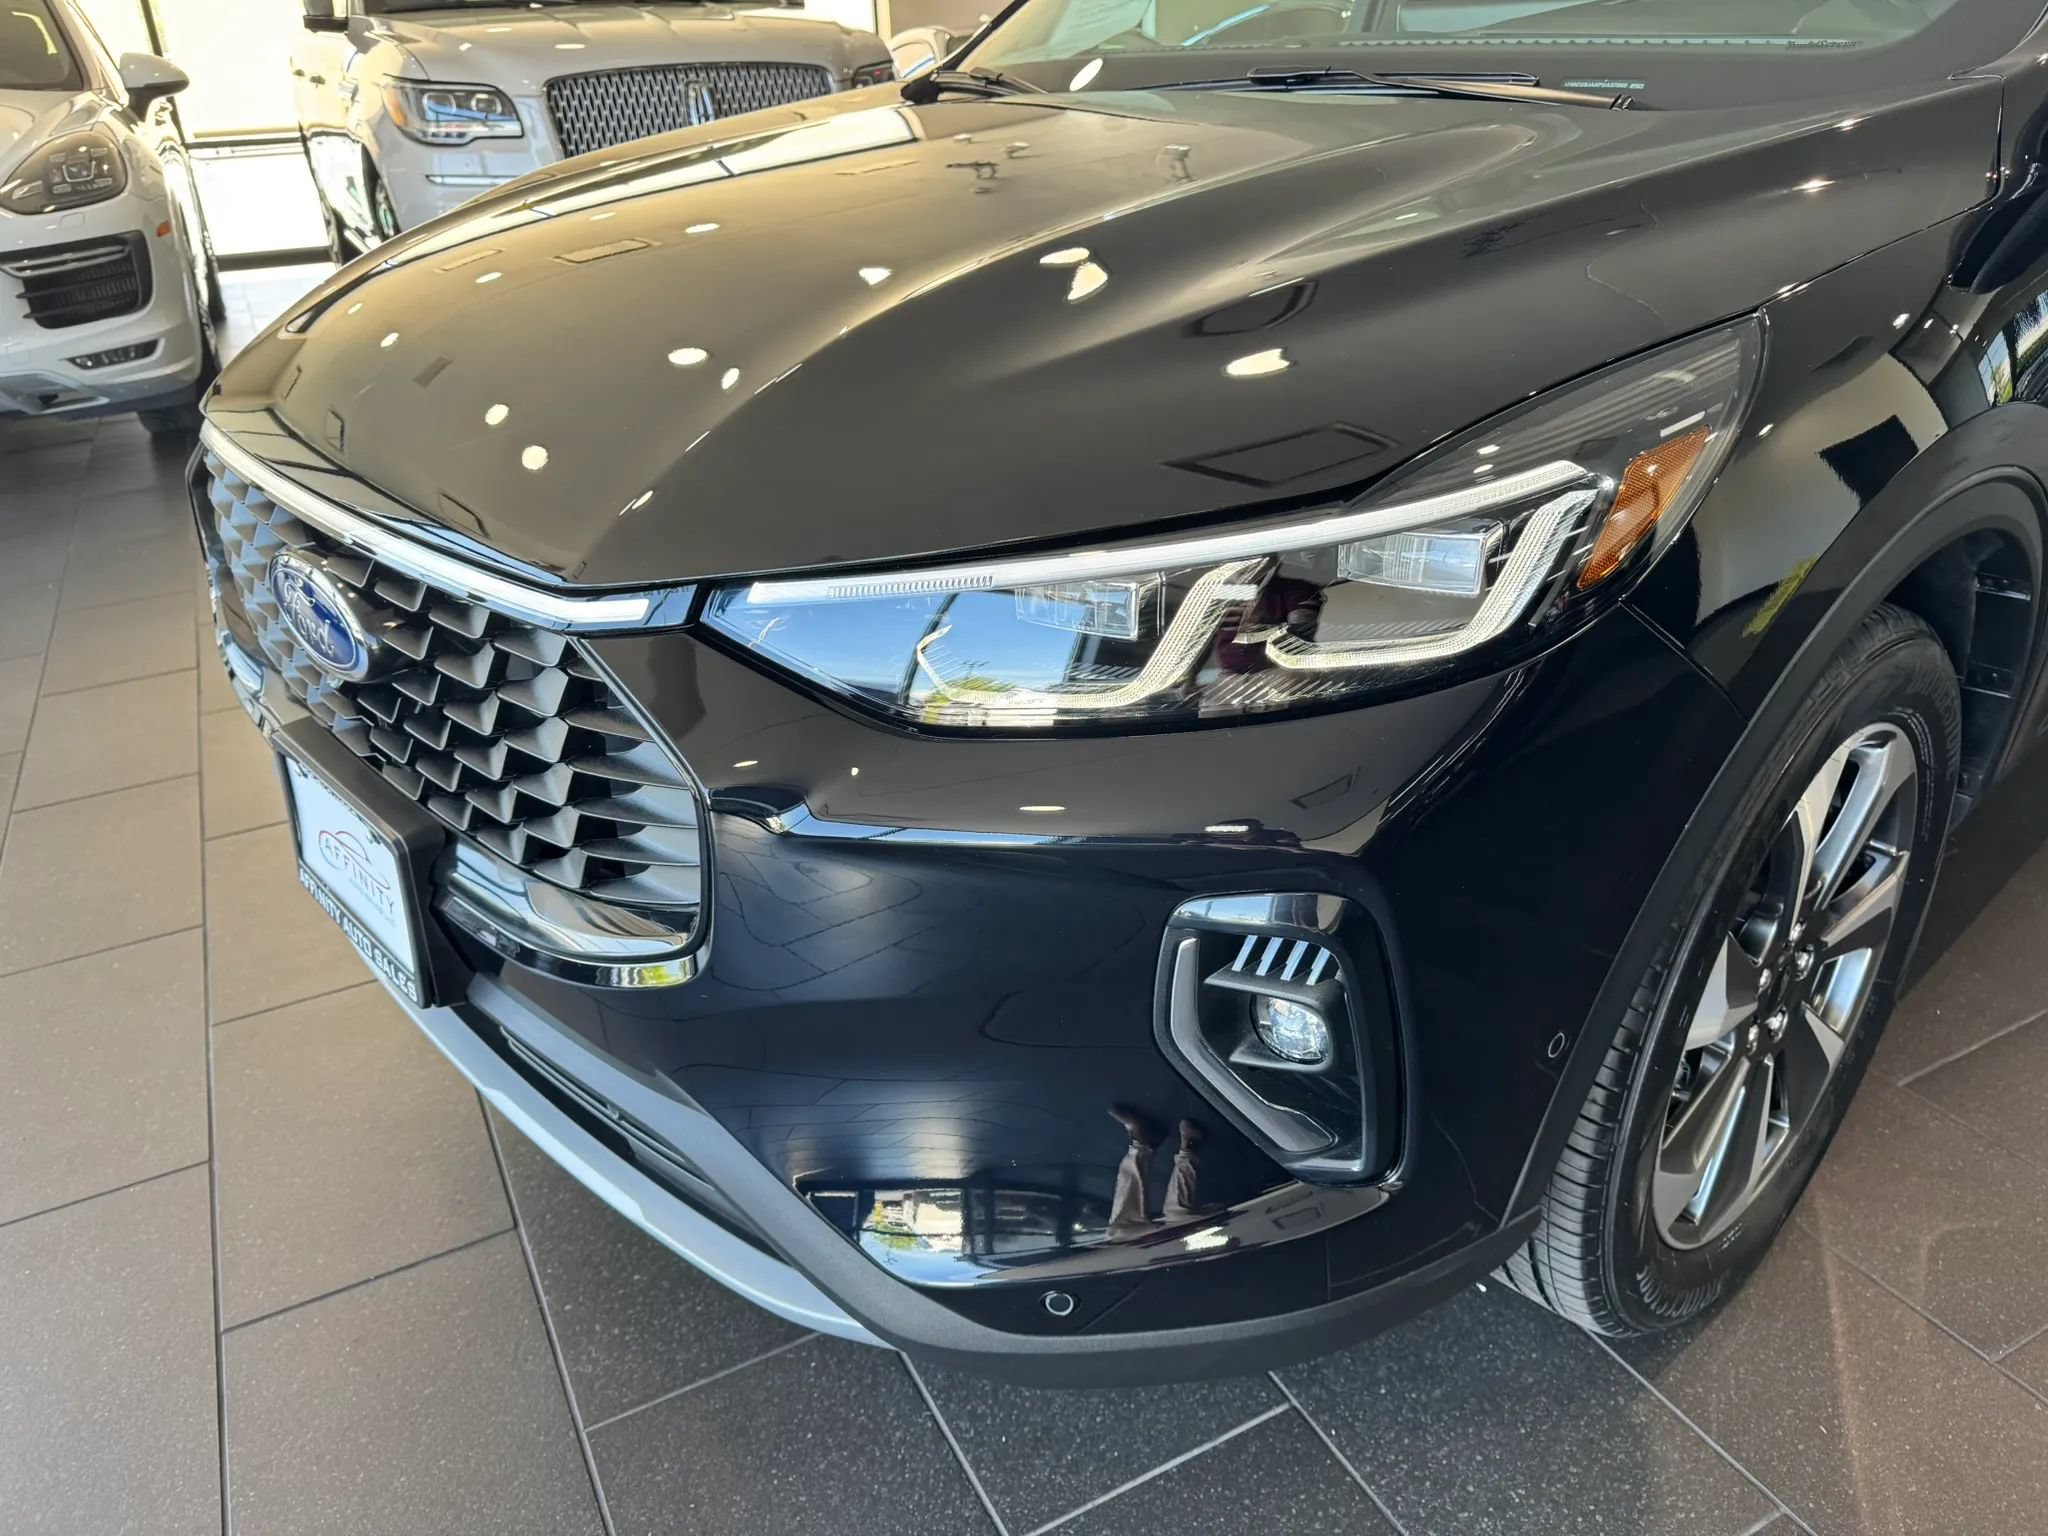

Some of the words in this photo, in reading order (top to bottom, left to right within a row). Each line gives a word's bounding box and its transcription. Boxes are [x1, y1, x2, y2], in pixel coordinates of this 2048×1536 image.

[284, 580, 335, 656] Ford
[325, 837, 394, 914] AFFINITY
[299, 868, 340, 924] AFFINITY
[342, 916, 373, 957] AUTO
[374, 948, 418, 1002] SALES
